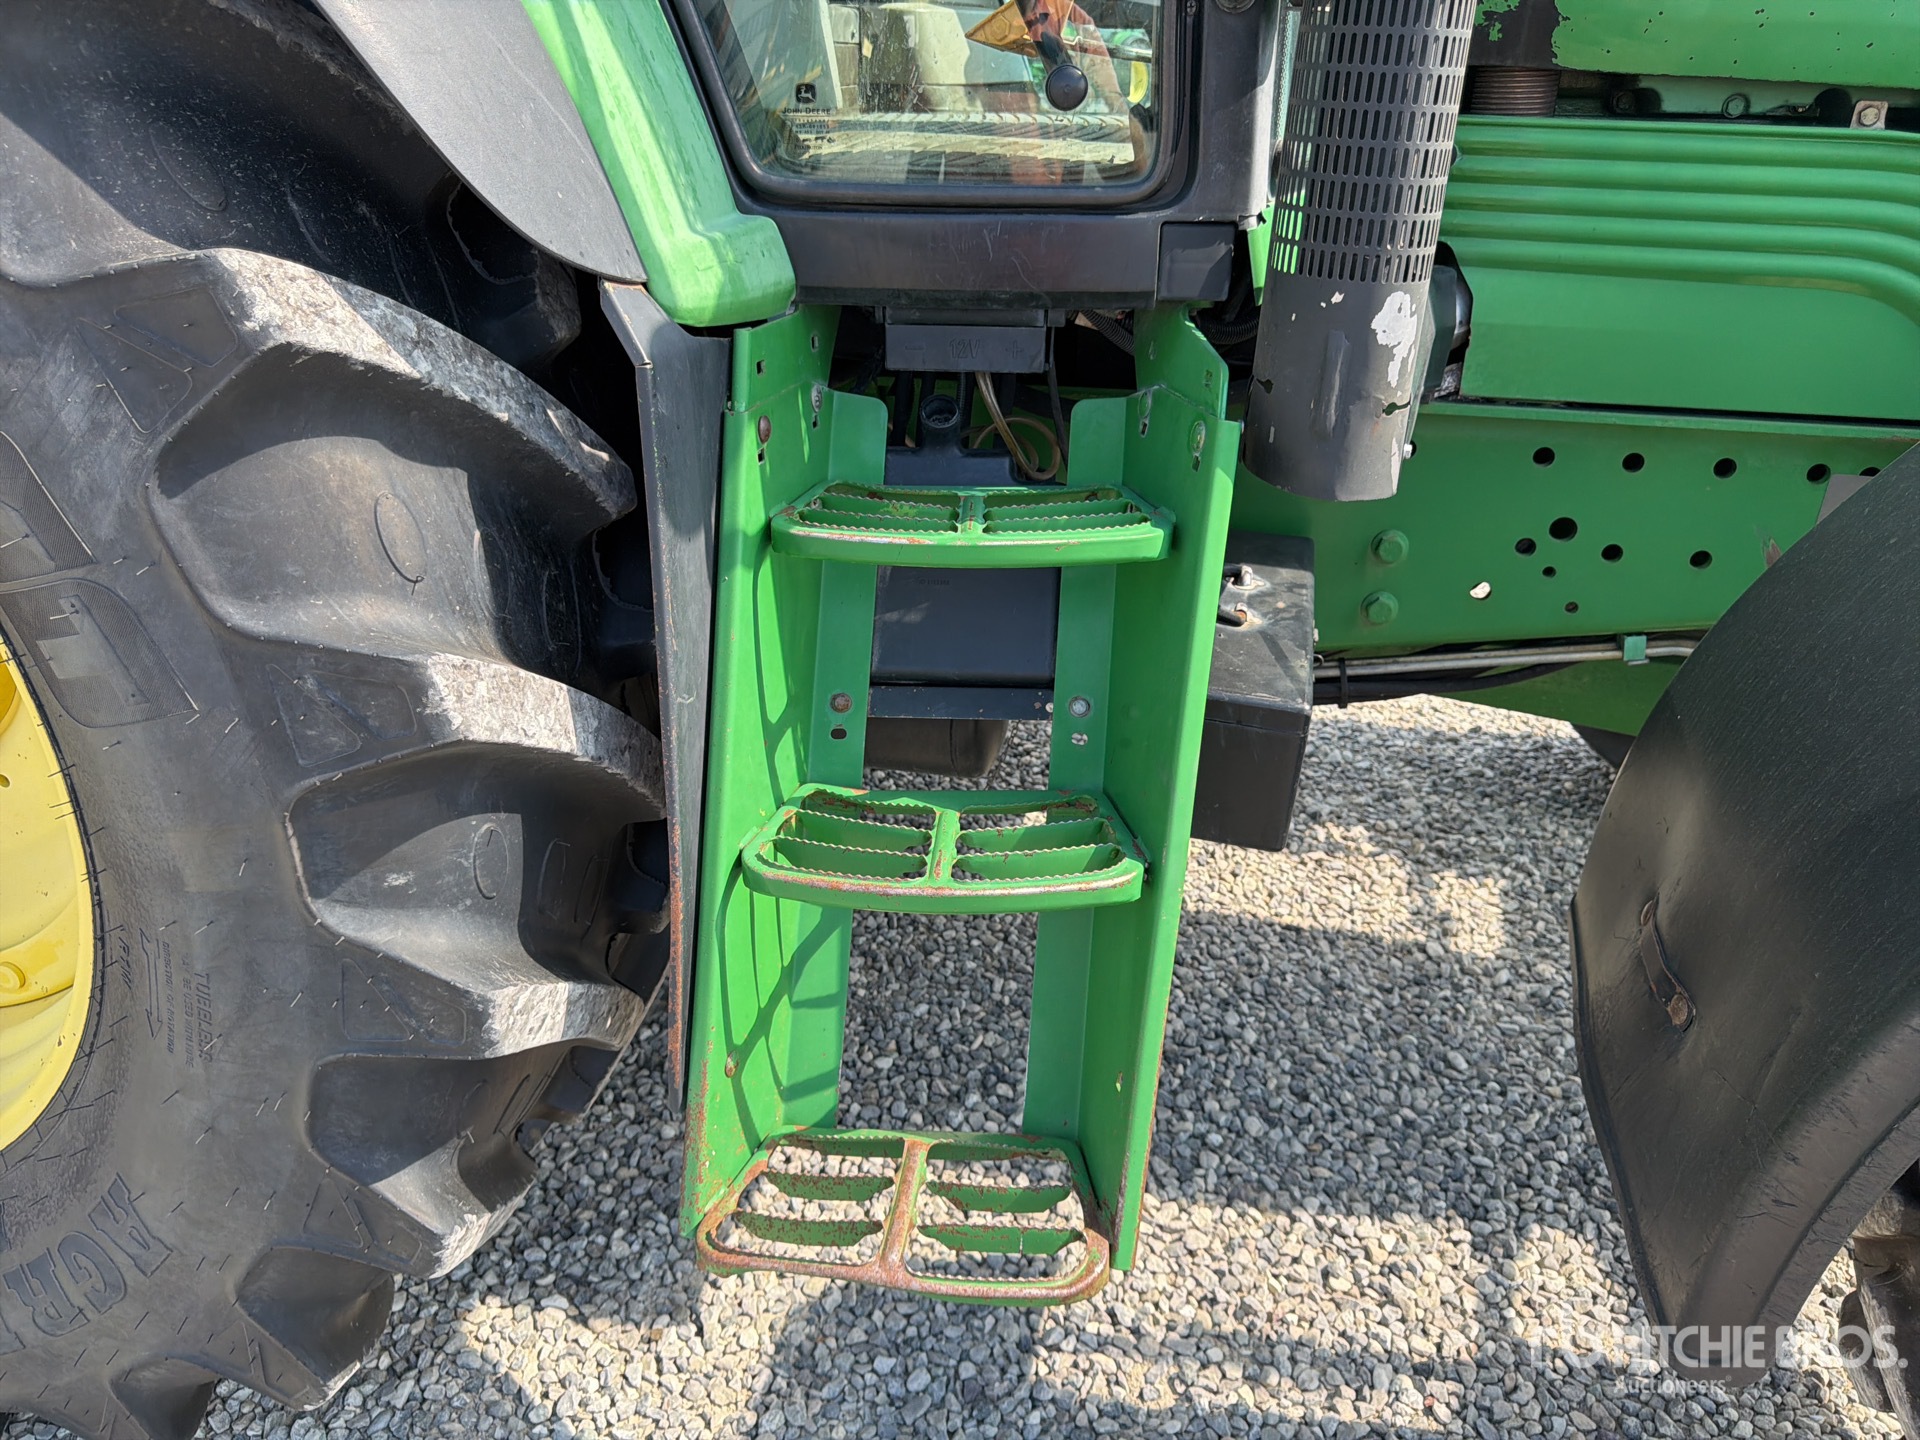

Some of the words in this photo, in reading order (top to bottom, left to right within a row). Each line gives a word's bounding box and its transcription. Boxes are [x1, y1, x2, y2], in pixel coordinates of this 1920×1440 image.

[782, 107, 803, 115] JOHN
[806, 107, 831, 115] DEERE
[950, 338, 981, 359] 12V
